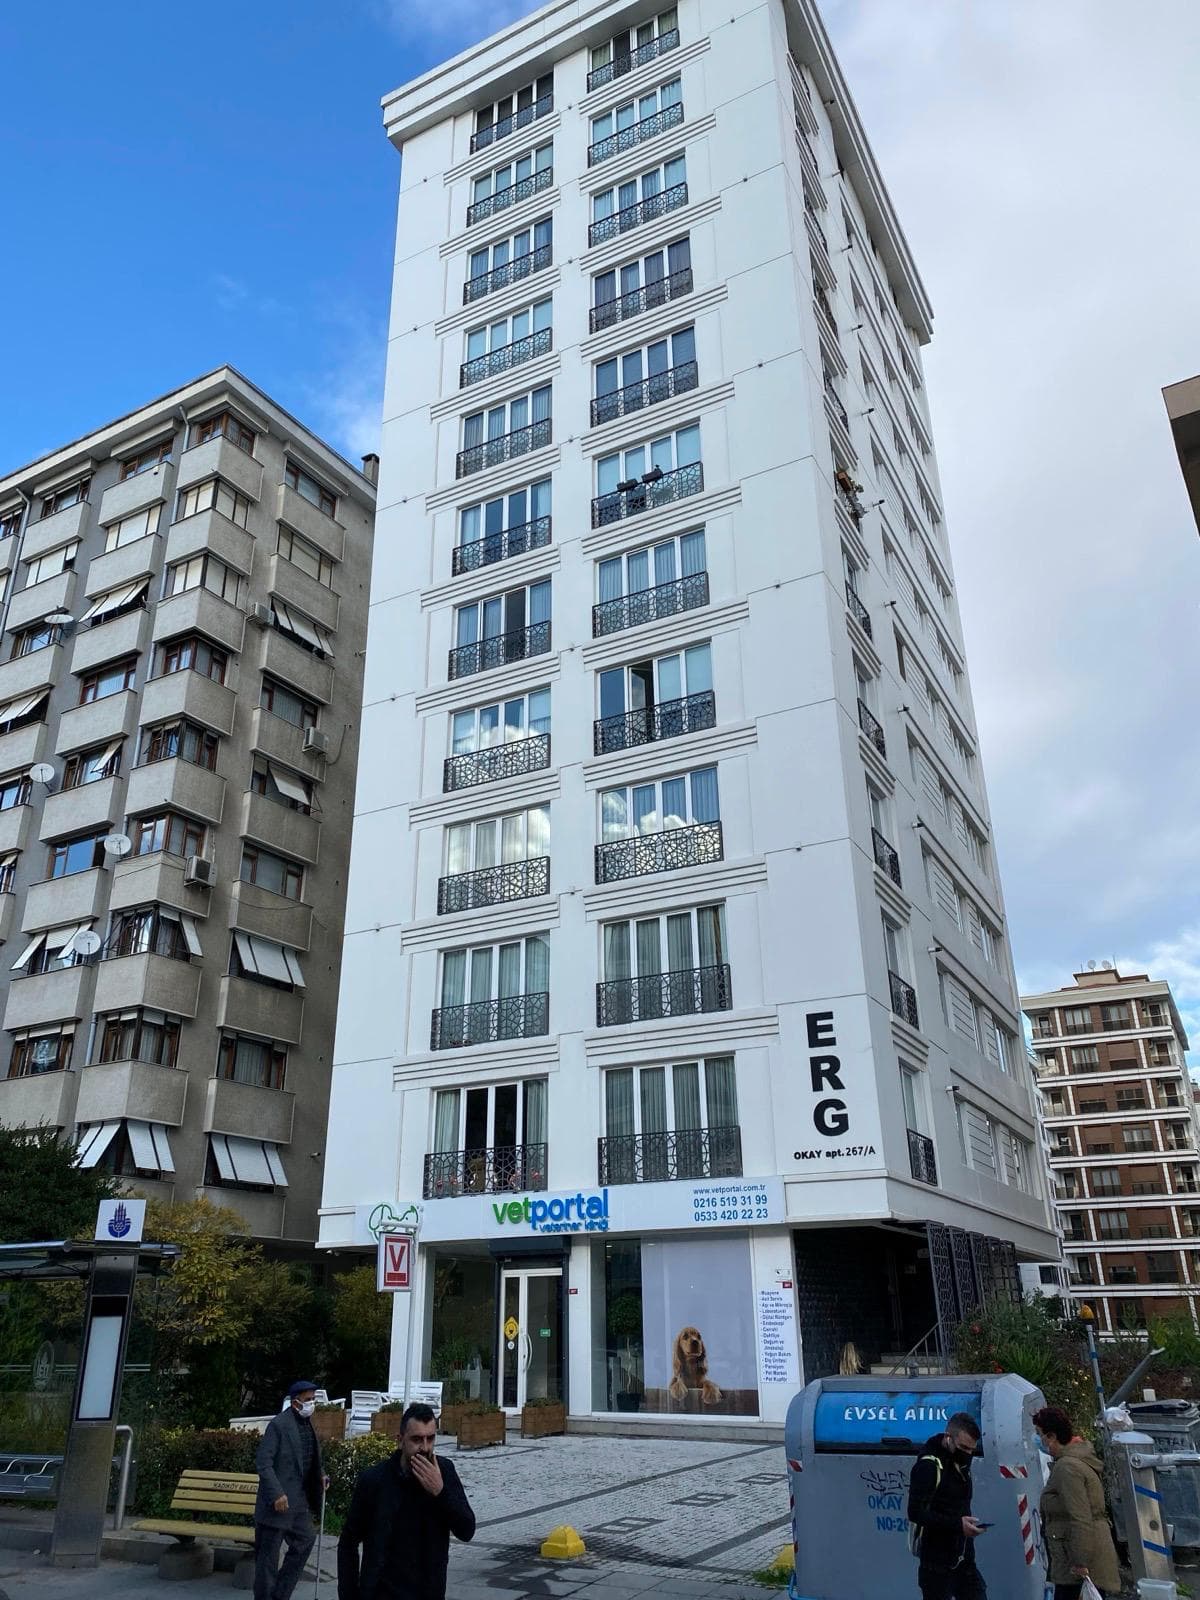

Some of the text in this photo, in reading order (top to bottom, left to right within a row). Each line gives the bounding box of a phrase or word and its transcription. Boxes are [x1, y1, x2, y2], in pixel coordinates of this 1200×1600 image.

[794, 1150, 822, 1160] OKAY
[846, 1145, 876, 1156] 267/A
[693, 1184, 766, 1195] www.vetportal.com.tr
[693, 1194, 768, 1208] 0216 519 31 99
[492, 1188, 608, 1230] vetportal
[694, 1208, 768, 1222] 0533 420 22 23
[844, 1405, 948, 1421] EVSEL ATIK
[868, 1495, 903, 1510] OKAY
